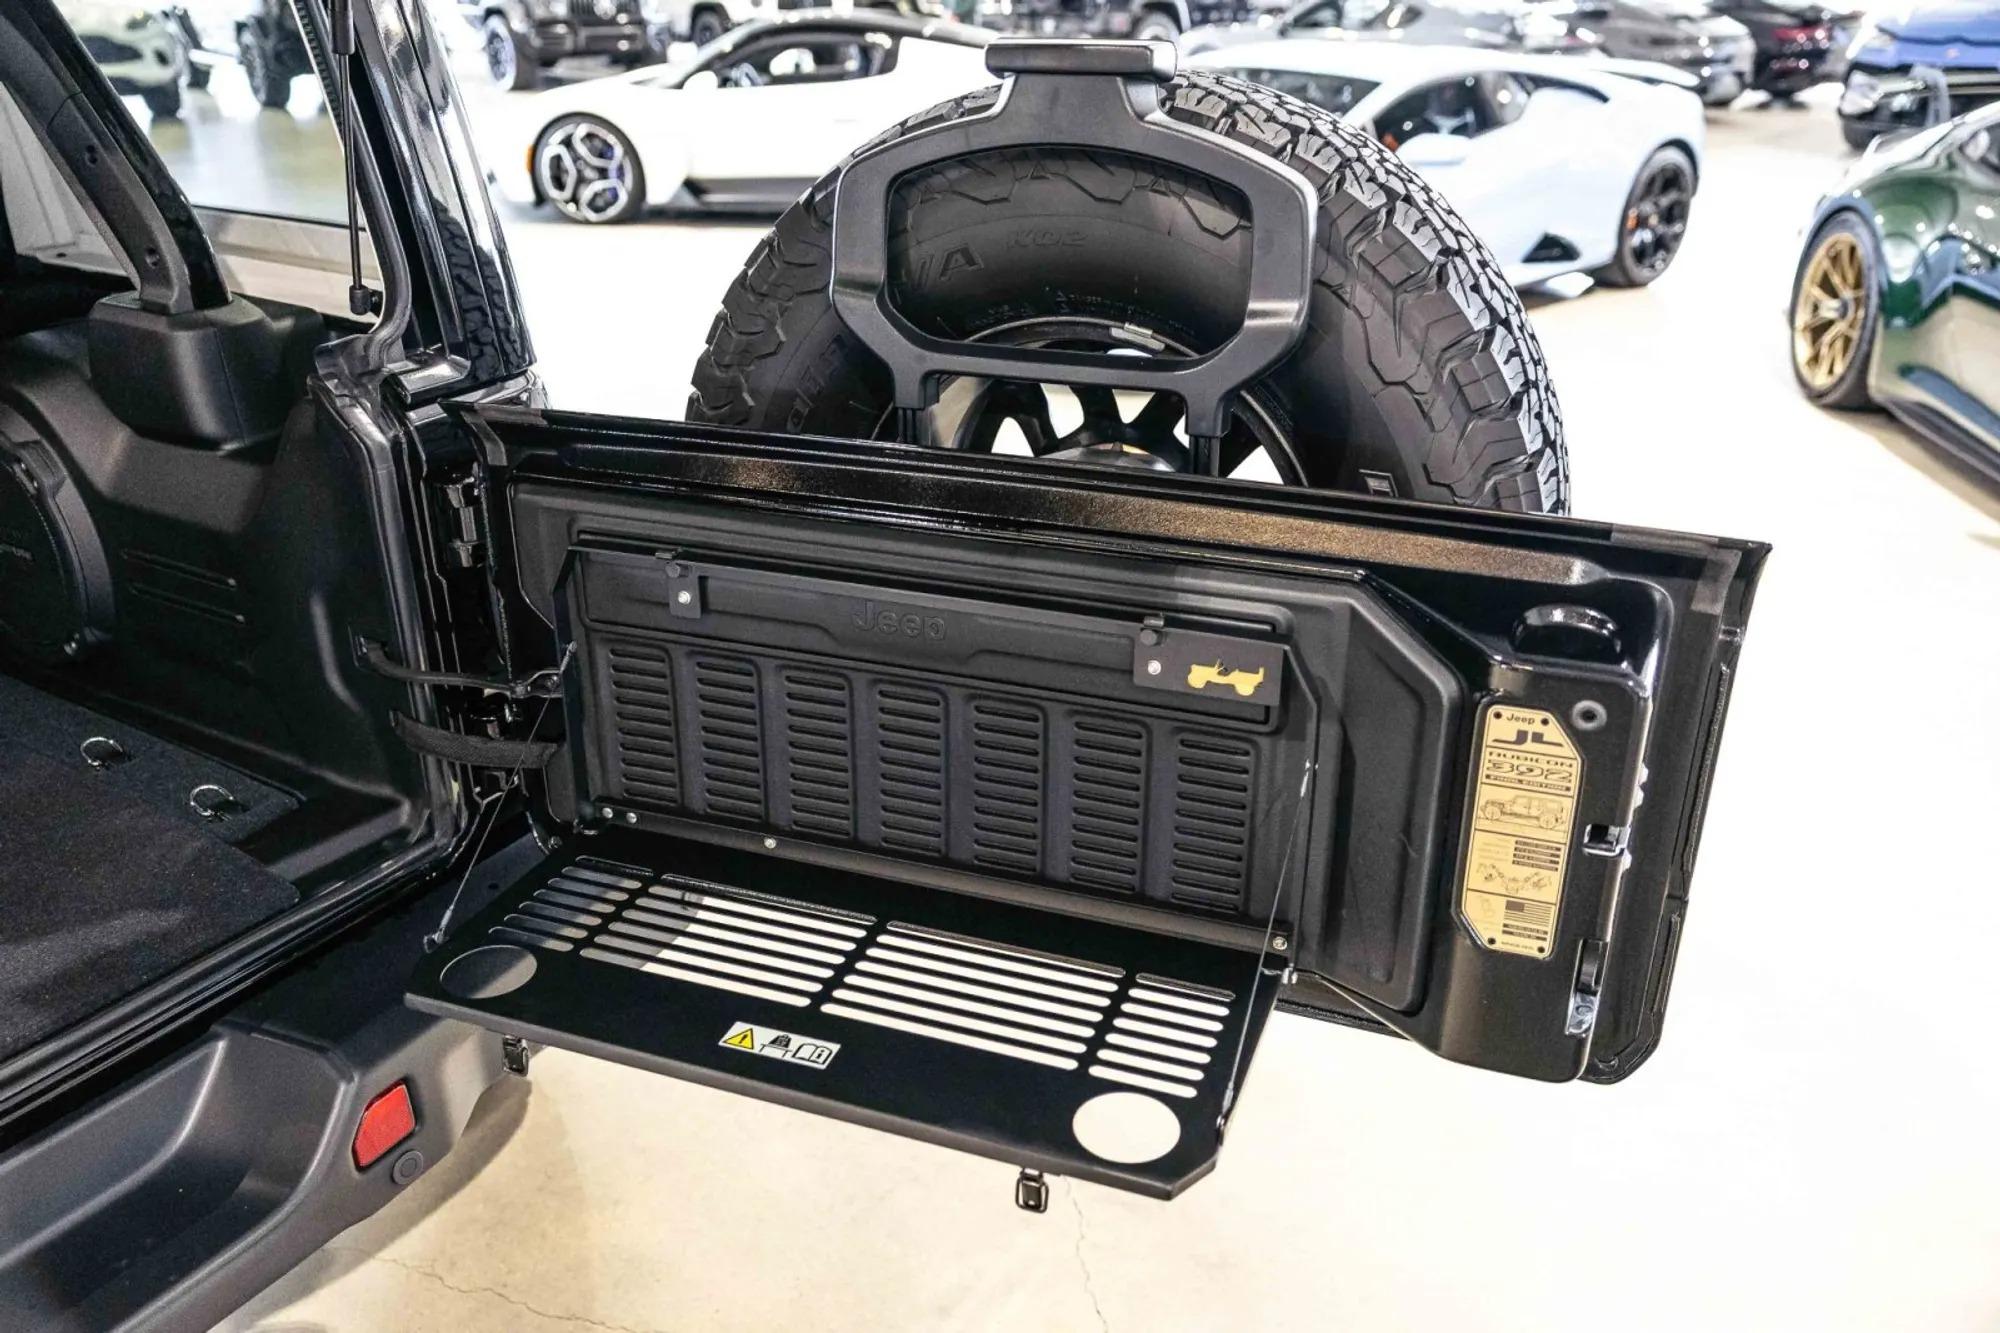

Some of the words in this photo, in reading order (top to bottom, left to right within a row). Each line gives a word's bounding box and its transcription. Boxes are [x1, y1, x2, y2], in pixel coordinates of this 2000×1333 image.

[850, 600, 946, 641] Jeep
[1506, 713, 1535, 725] Jeep
[1486, 759, 1573, 783] 392
